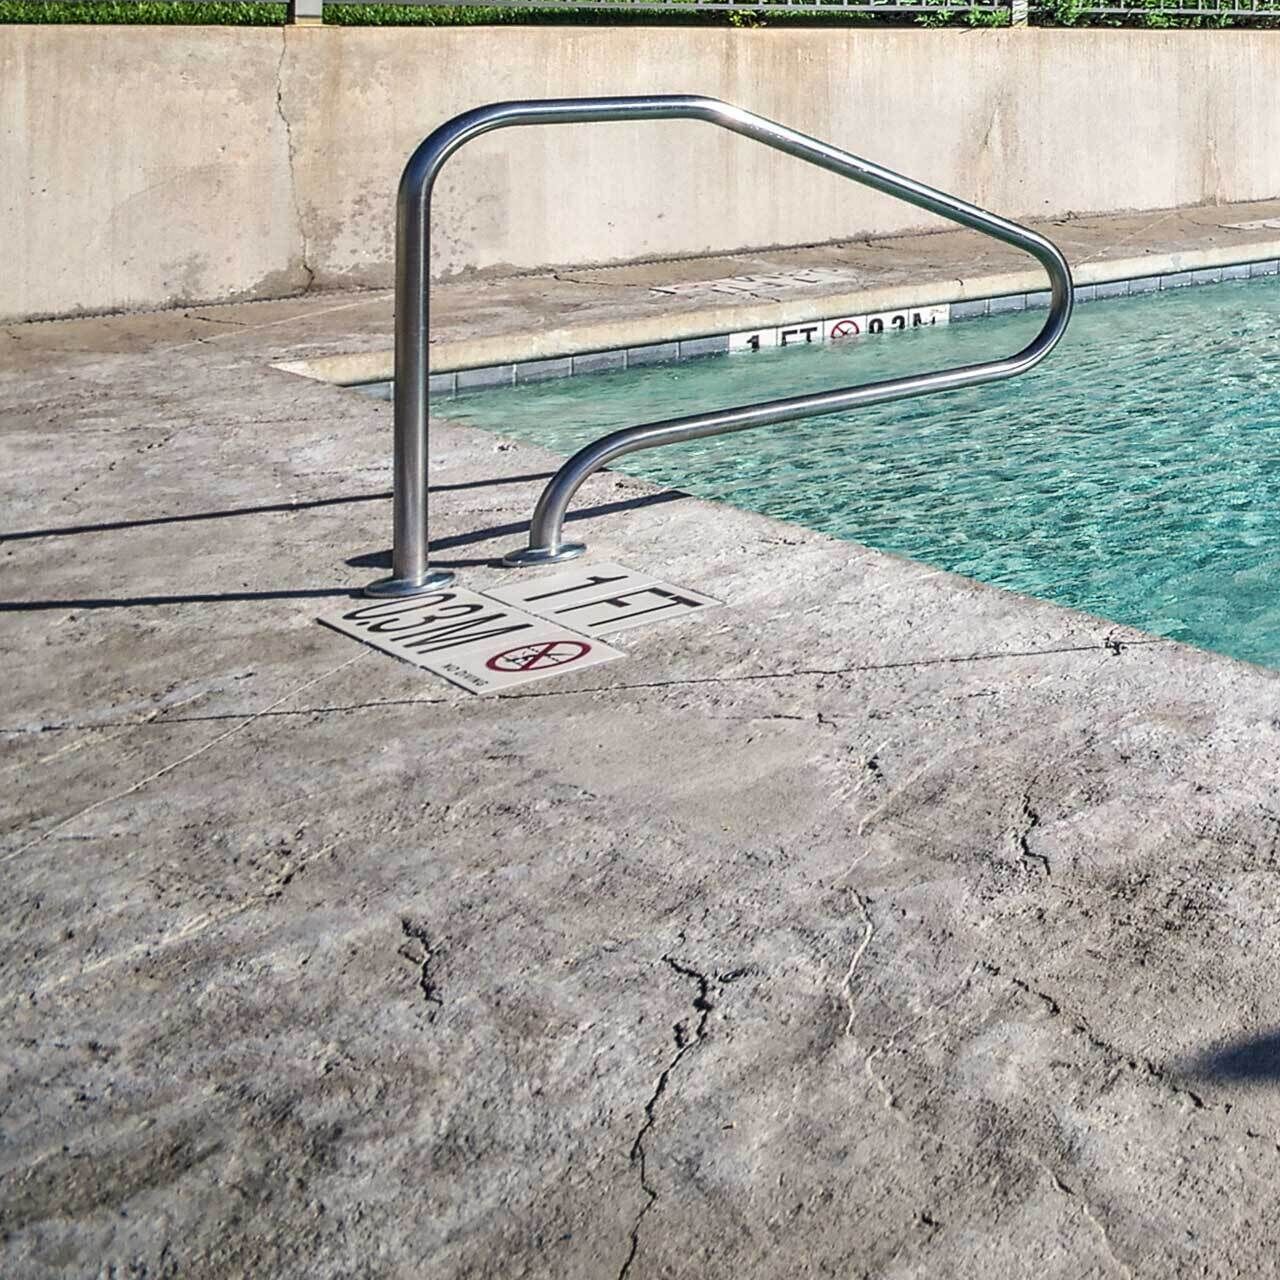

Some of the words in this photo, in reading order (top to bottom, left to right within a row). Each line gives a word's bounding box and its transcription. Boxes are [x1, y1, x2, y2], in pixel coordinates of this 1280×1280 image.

[523, 575, 629, 602] 1
[554, 587, 705, 627] FT
[342, 593, 535, 655] 0.3M
